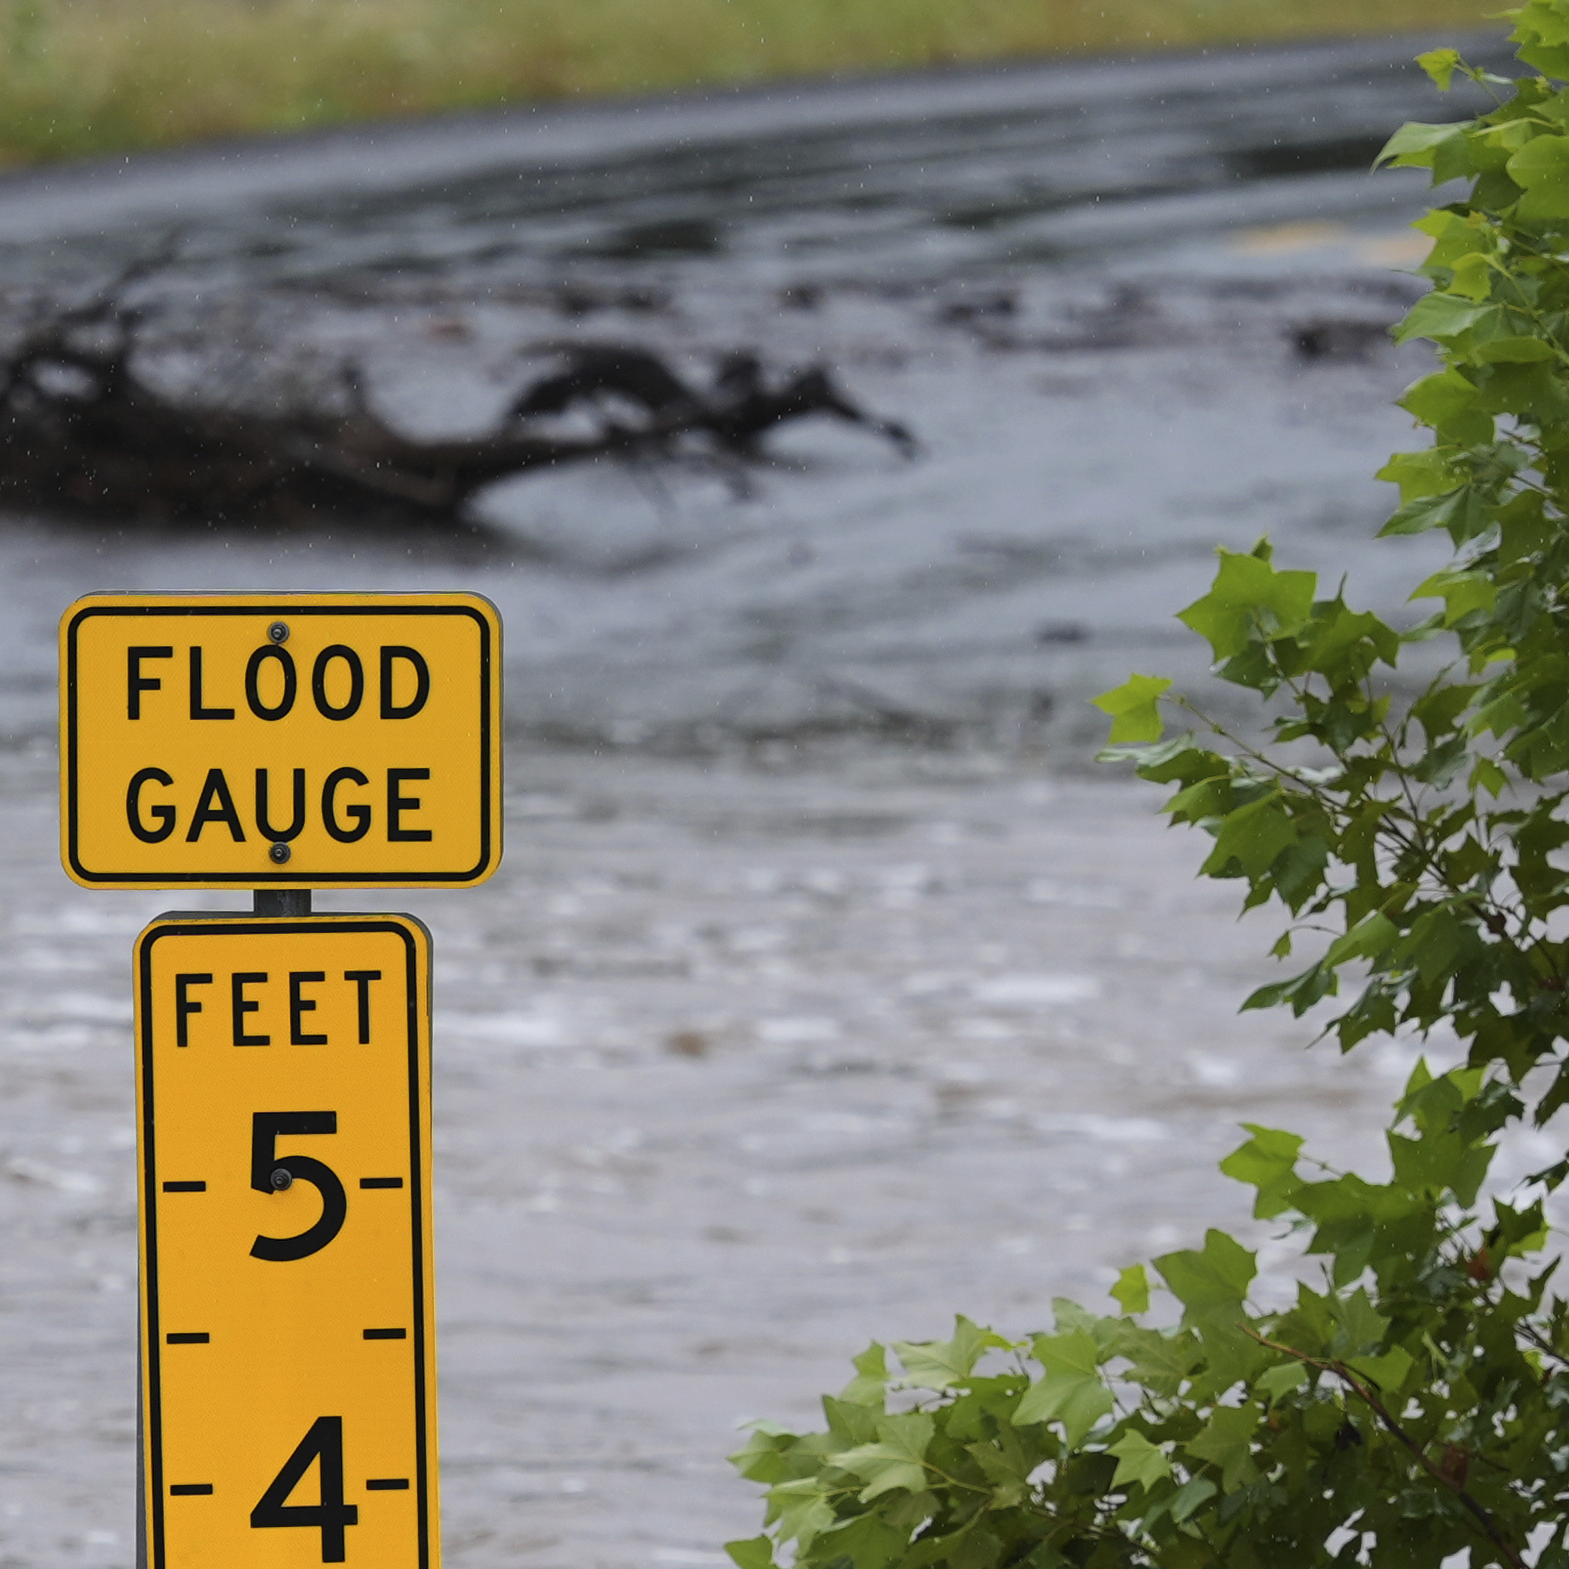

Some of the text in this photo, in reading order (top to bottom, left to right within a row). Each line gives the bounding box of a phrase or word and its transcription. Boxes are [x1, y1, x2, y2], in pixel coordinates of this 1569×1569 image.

[126, 643, 431, 722] FLOOD
[125, 766, 433, 844] GAUGE
[175, 969, 382, 1048] FEET
[249, 1110, 348, 1262] 5
[250, 1415, 359, 1564] 4
